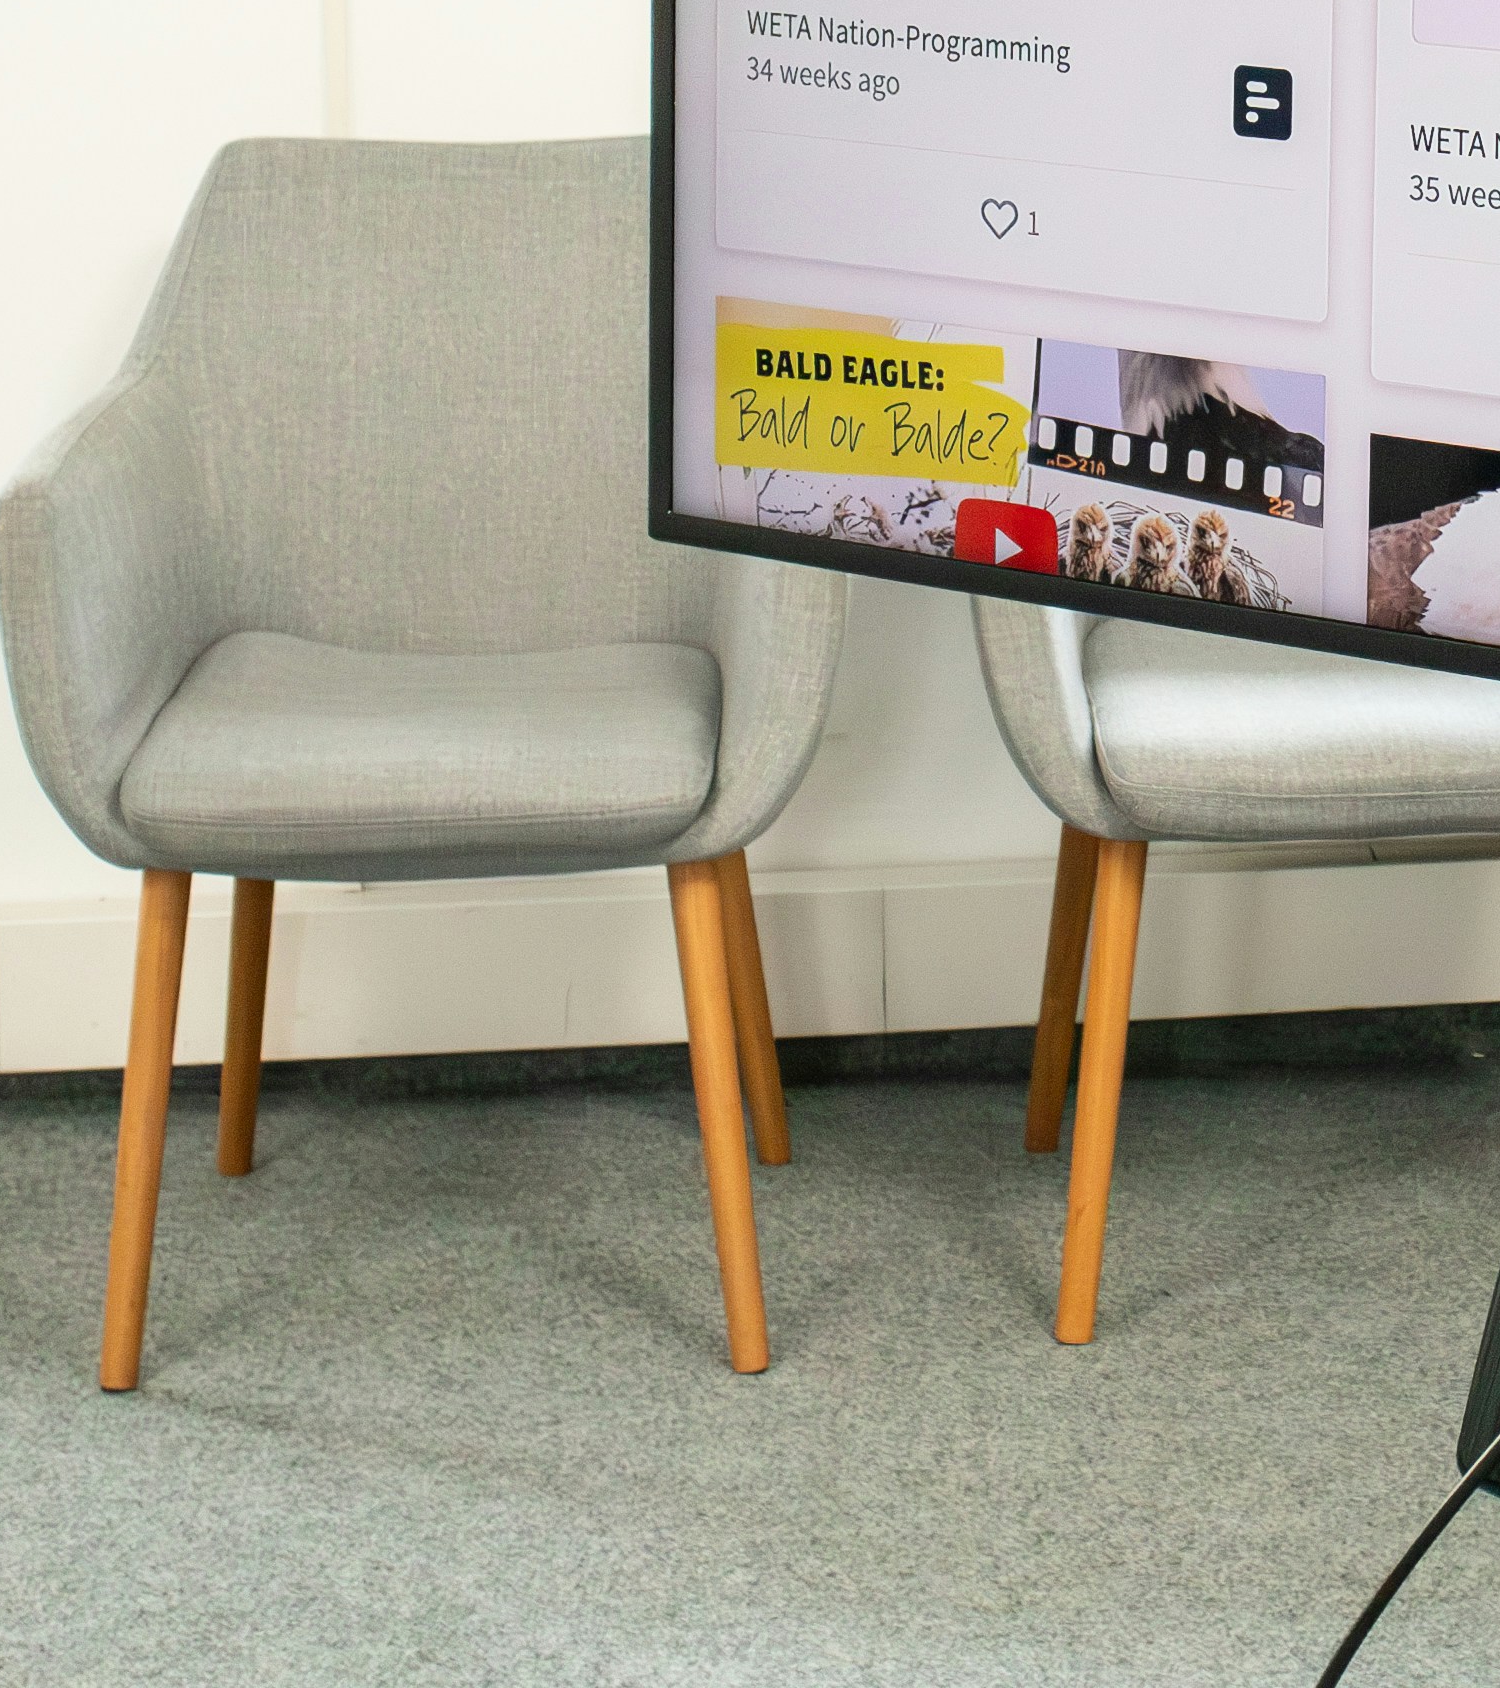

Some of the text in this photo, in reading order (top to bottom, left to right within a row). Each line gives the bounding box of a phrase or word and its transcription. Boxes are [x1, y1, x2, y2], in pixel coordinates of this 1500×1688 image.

[747, 9, 1071, 74] WETA Nation-Programming
[746, 56, 900, 102] 34 weeks ago
[1410, 124, 1486, 159] WETA
[1409, 174, 1440, 203] 35
[1027, 211, 1040, 236] 1
[755, 348, 946, 393] BALD EAGLE:
[730, 387, 1012, 465] Bald or Balde?
